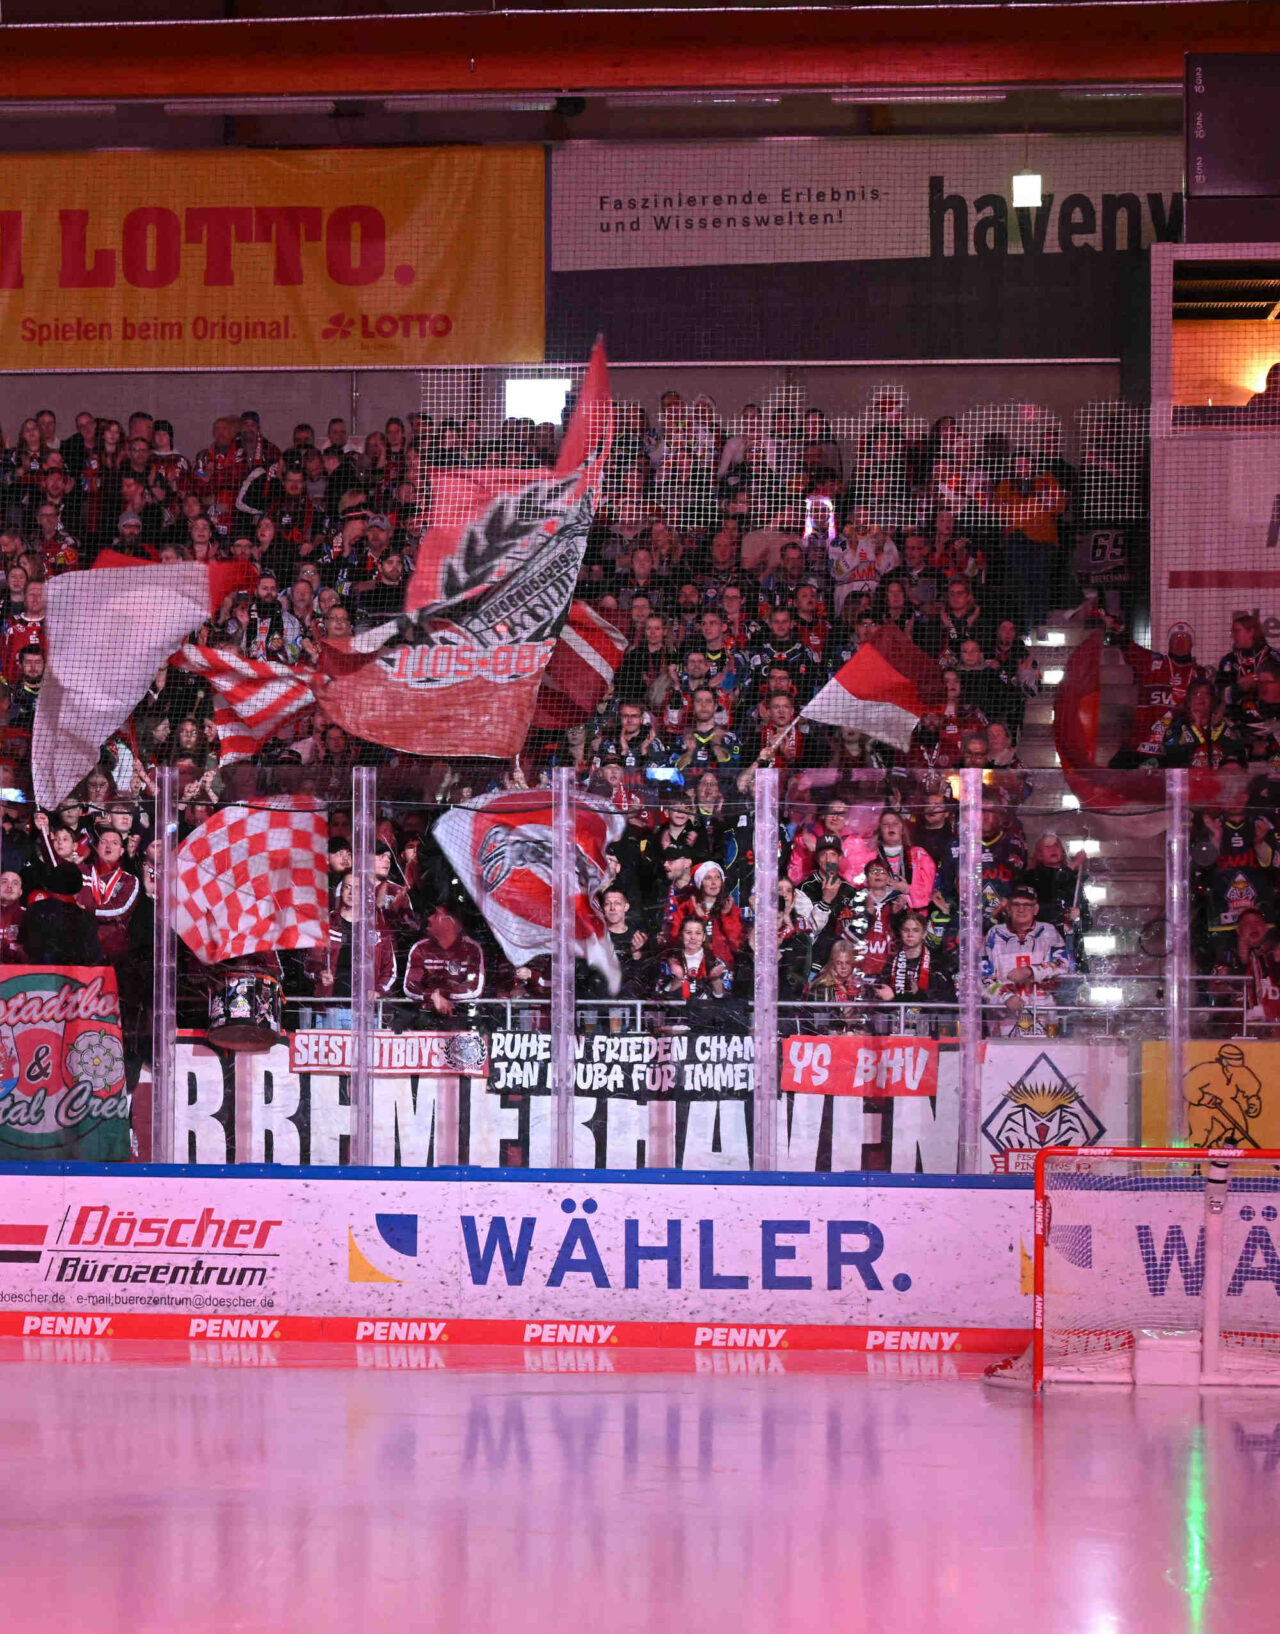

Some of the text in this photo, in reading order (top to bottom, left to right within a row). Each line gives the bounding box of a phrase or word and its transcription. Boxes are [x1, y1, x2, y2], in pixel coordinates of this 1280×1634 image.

[599, 185, 891, 210] Faszinierende Erlebnis-
[599, 209, 844, 233] und Wissenswelten!
[58, 205, 416, 289] LOTTO.
[21, 313, 453, 347] Spielen beim Original. LOTTO
[26, 1044, 53, 1082] &
[491, 1032, 552, 1060] RUHE
[592, 1034, 689, 1063] FRIEDEN
[494, 1061, 539, 1090] JAN
[631, 1063, 676, 1093] FÜR
[789, 1040, 931, 1091] YS BHV
[68, 1206, 282, 1250] Döscher
[460, 1198, 913, 1291] WÄHLER.
[56, 1256, 267, 1286] Bürozentrum
